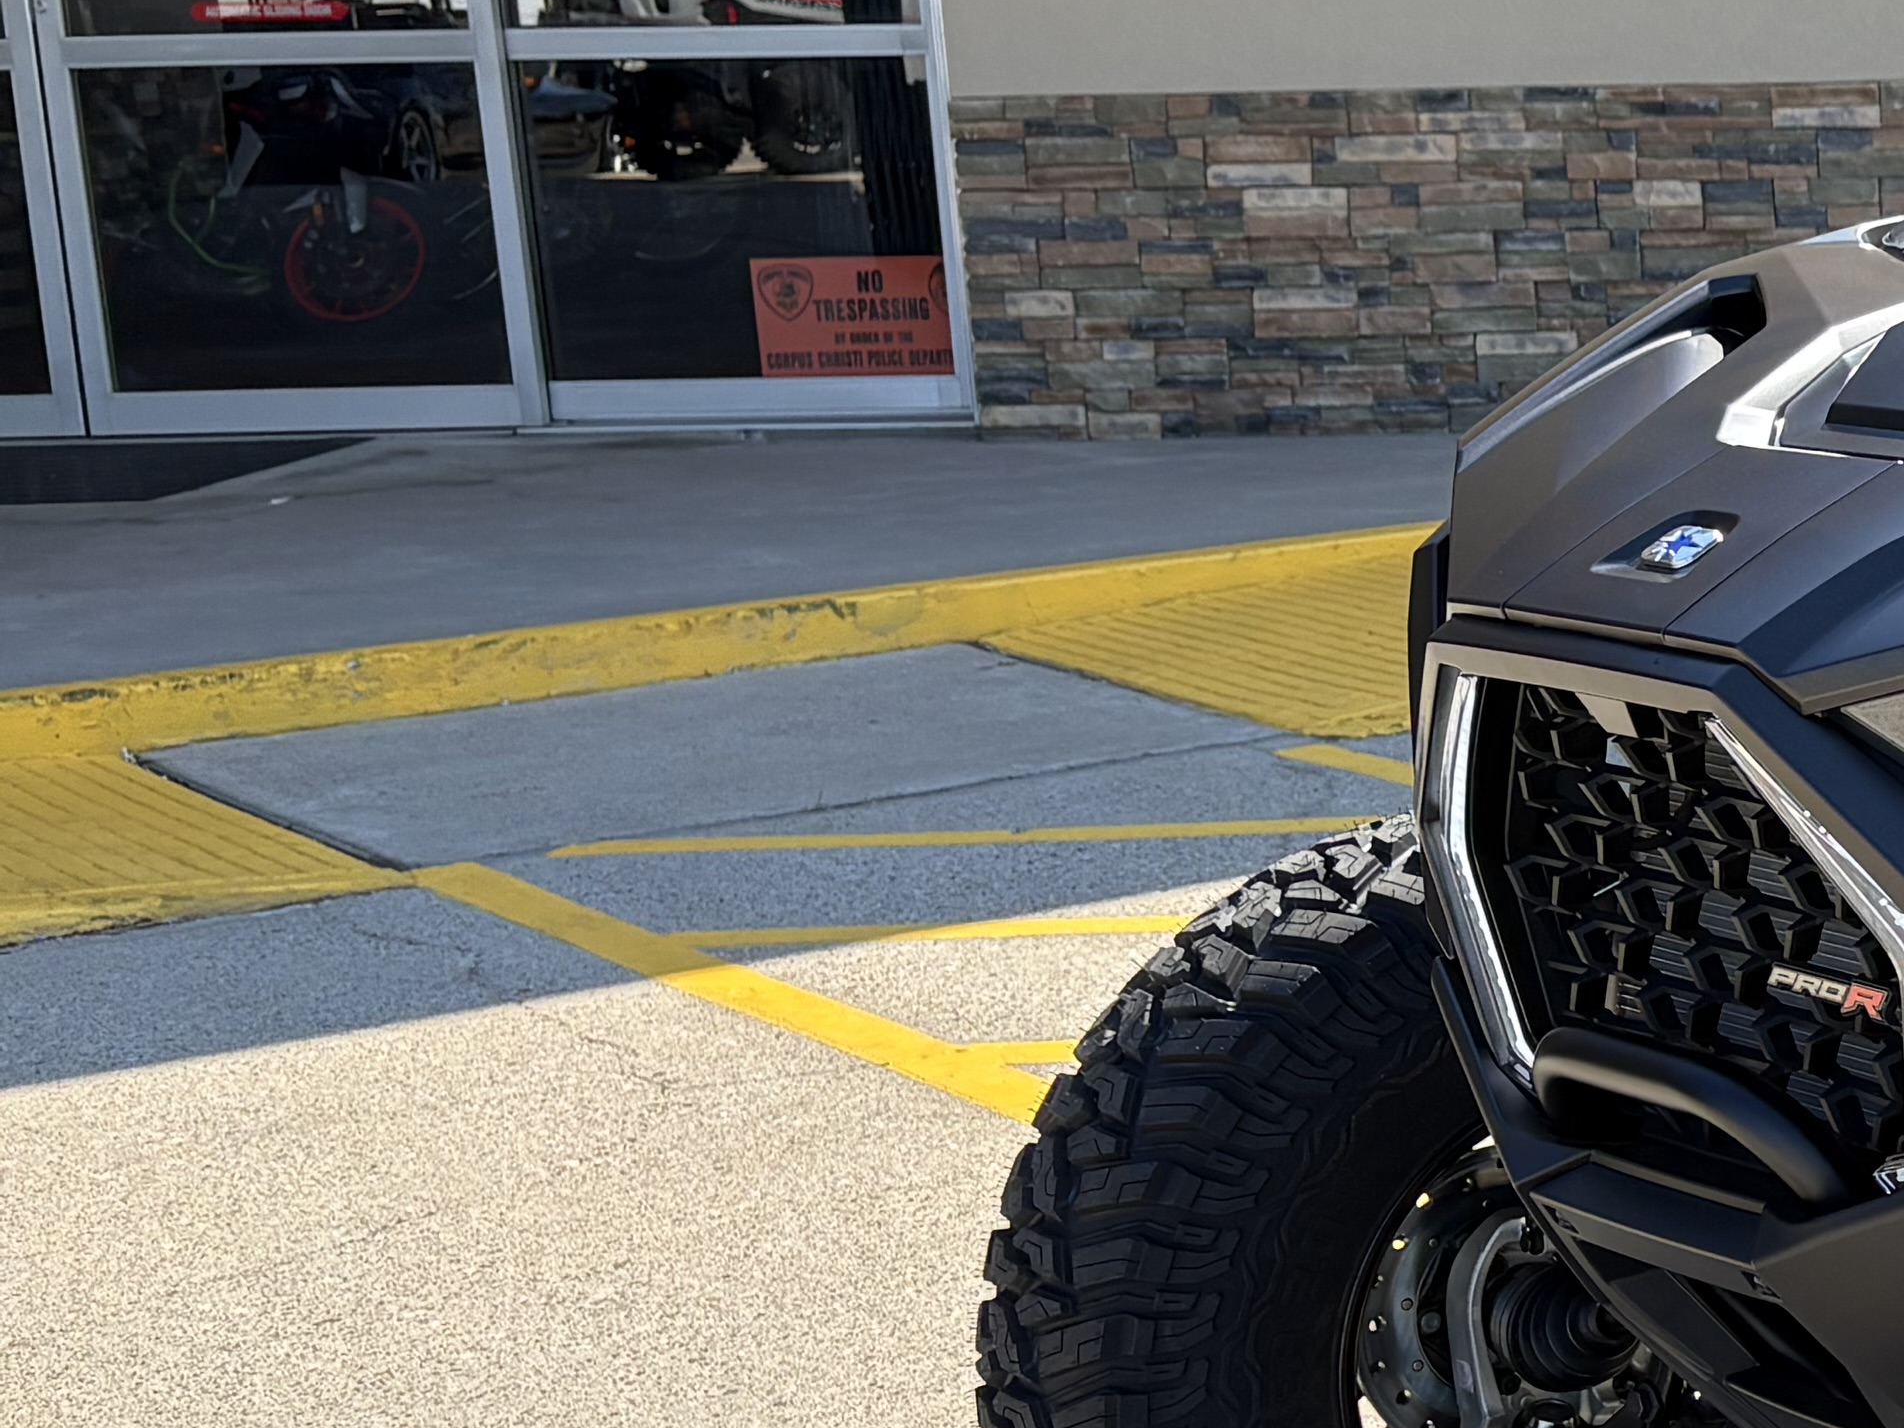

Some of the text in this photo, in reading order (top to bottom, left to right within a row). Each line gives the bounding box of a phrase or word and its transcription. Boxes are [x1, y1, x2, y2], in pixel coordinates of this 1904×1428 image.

[856, 269, 883, 294] NO
[813, 296, 930, 322] TRESPASSING
[850, 331, 880, 344] ORDER
[766, 351, 814, 369] CORPUS
[817, 350, 864, 369] CHRISTI
[868, 349, 904, 368] POLICE
